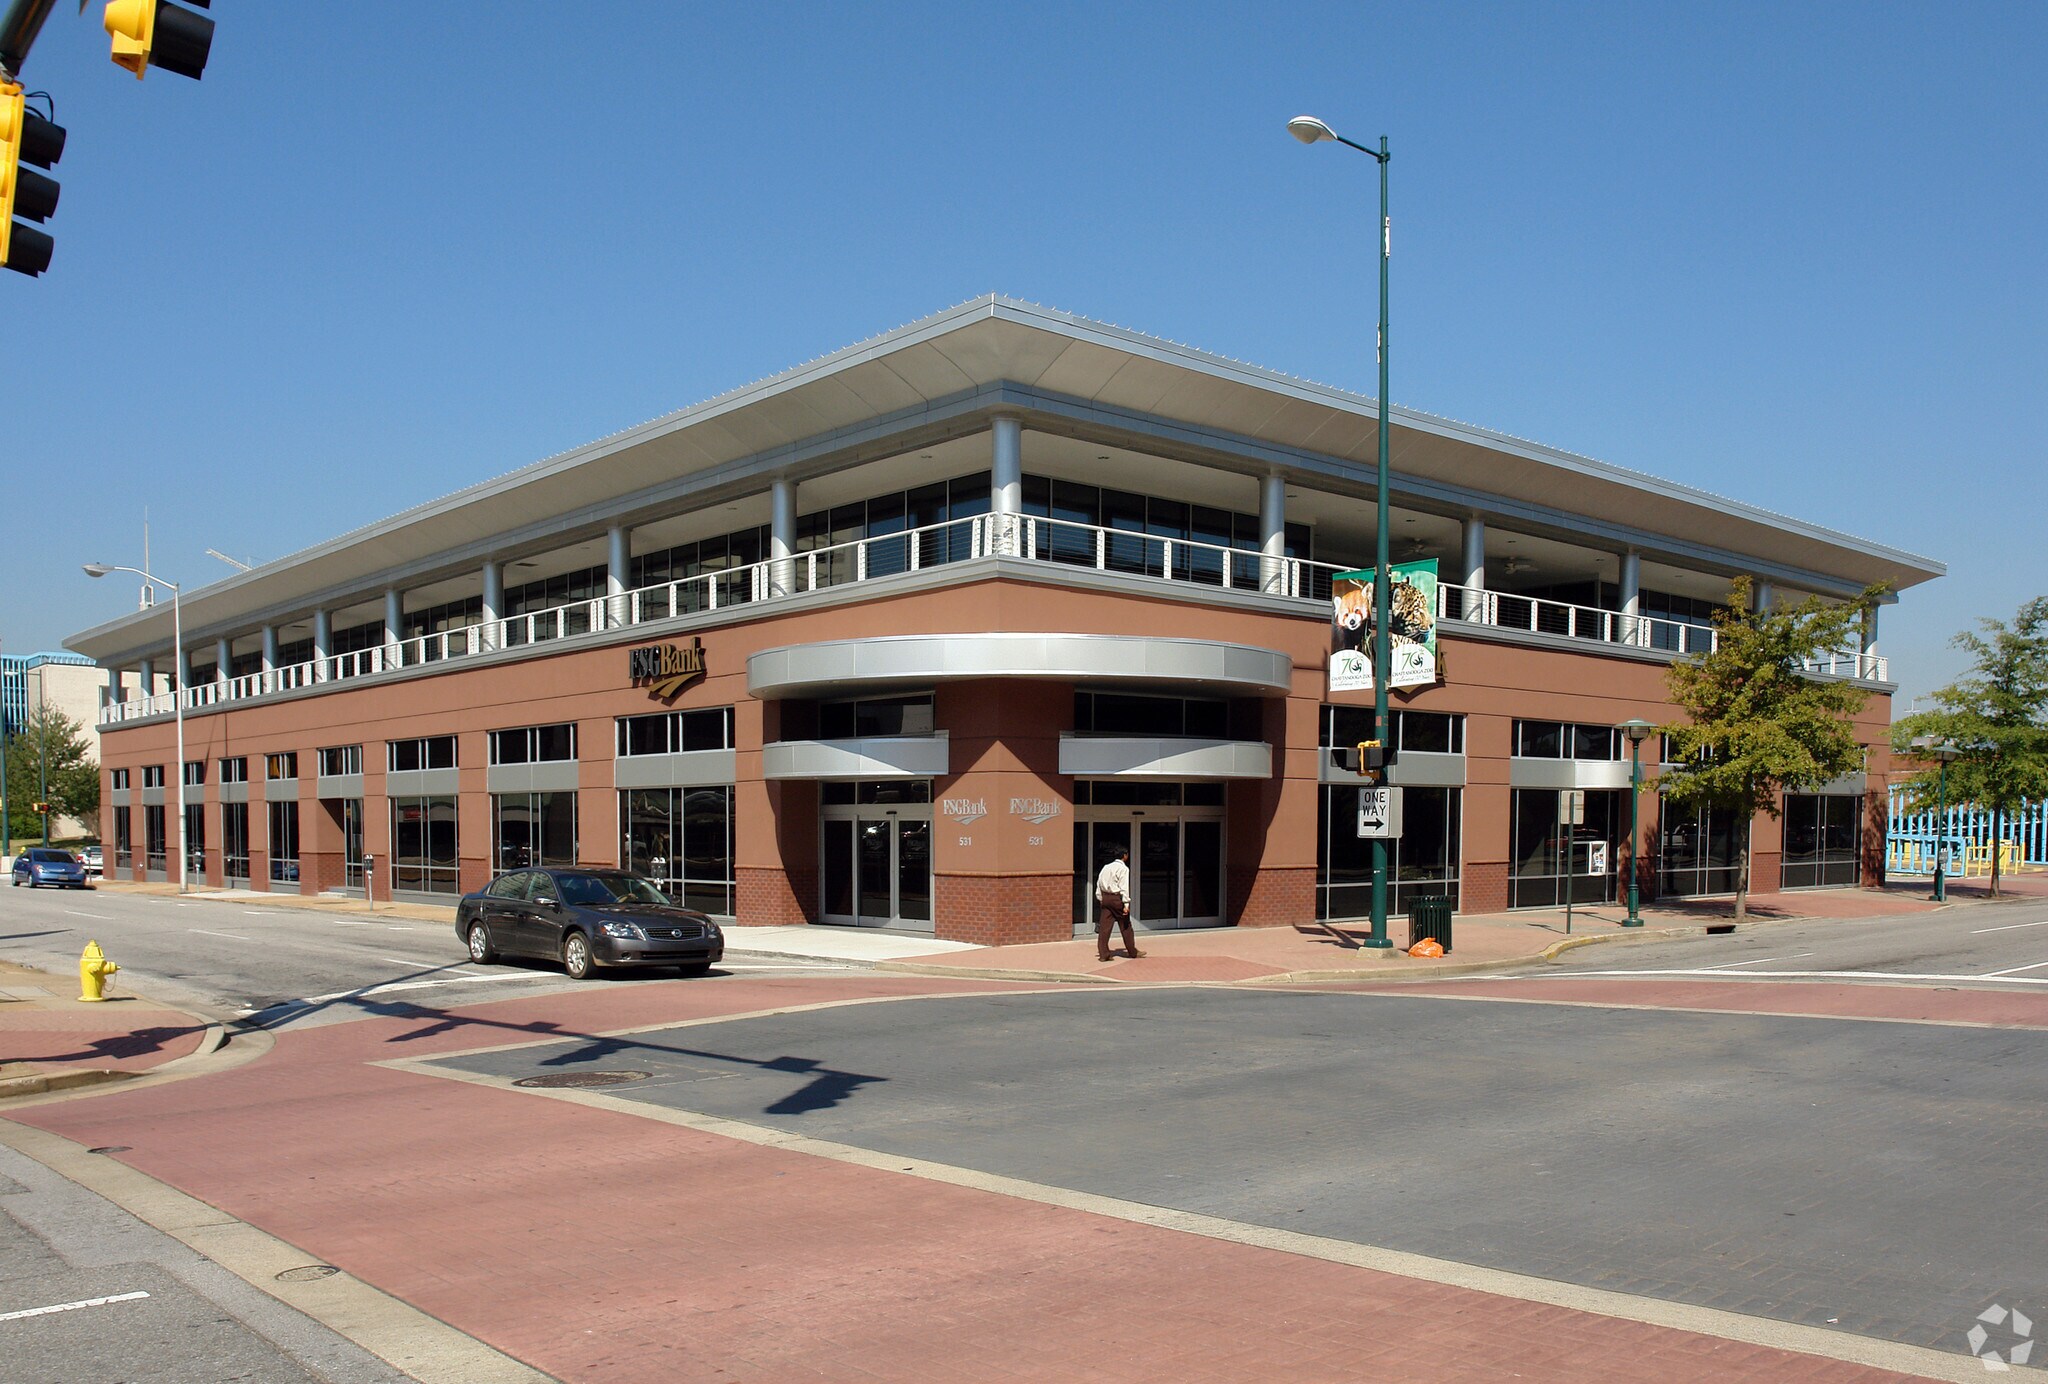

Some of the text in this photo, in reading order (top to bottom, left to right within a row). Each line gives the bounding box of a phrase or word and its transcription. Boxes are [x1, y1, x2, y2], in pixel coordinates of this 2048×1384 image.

[629, 637, 703, 679] FSGBank
[1364, 791, 1385, 803] ONE
[943, 798, 987, 815] FSGBank
[1009, 798, 1061, 814] FSGBank
[1362, 805, 1386, 816] WAY
[959, 836, 972, 846] 531
[1028, 836, 1044, 846] 531
